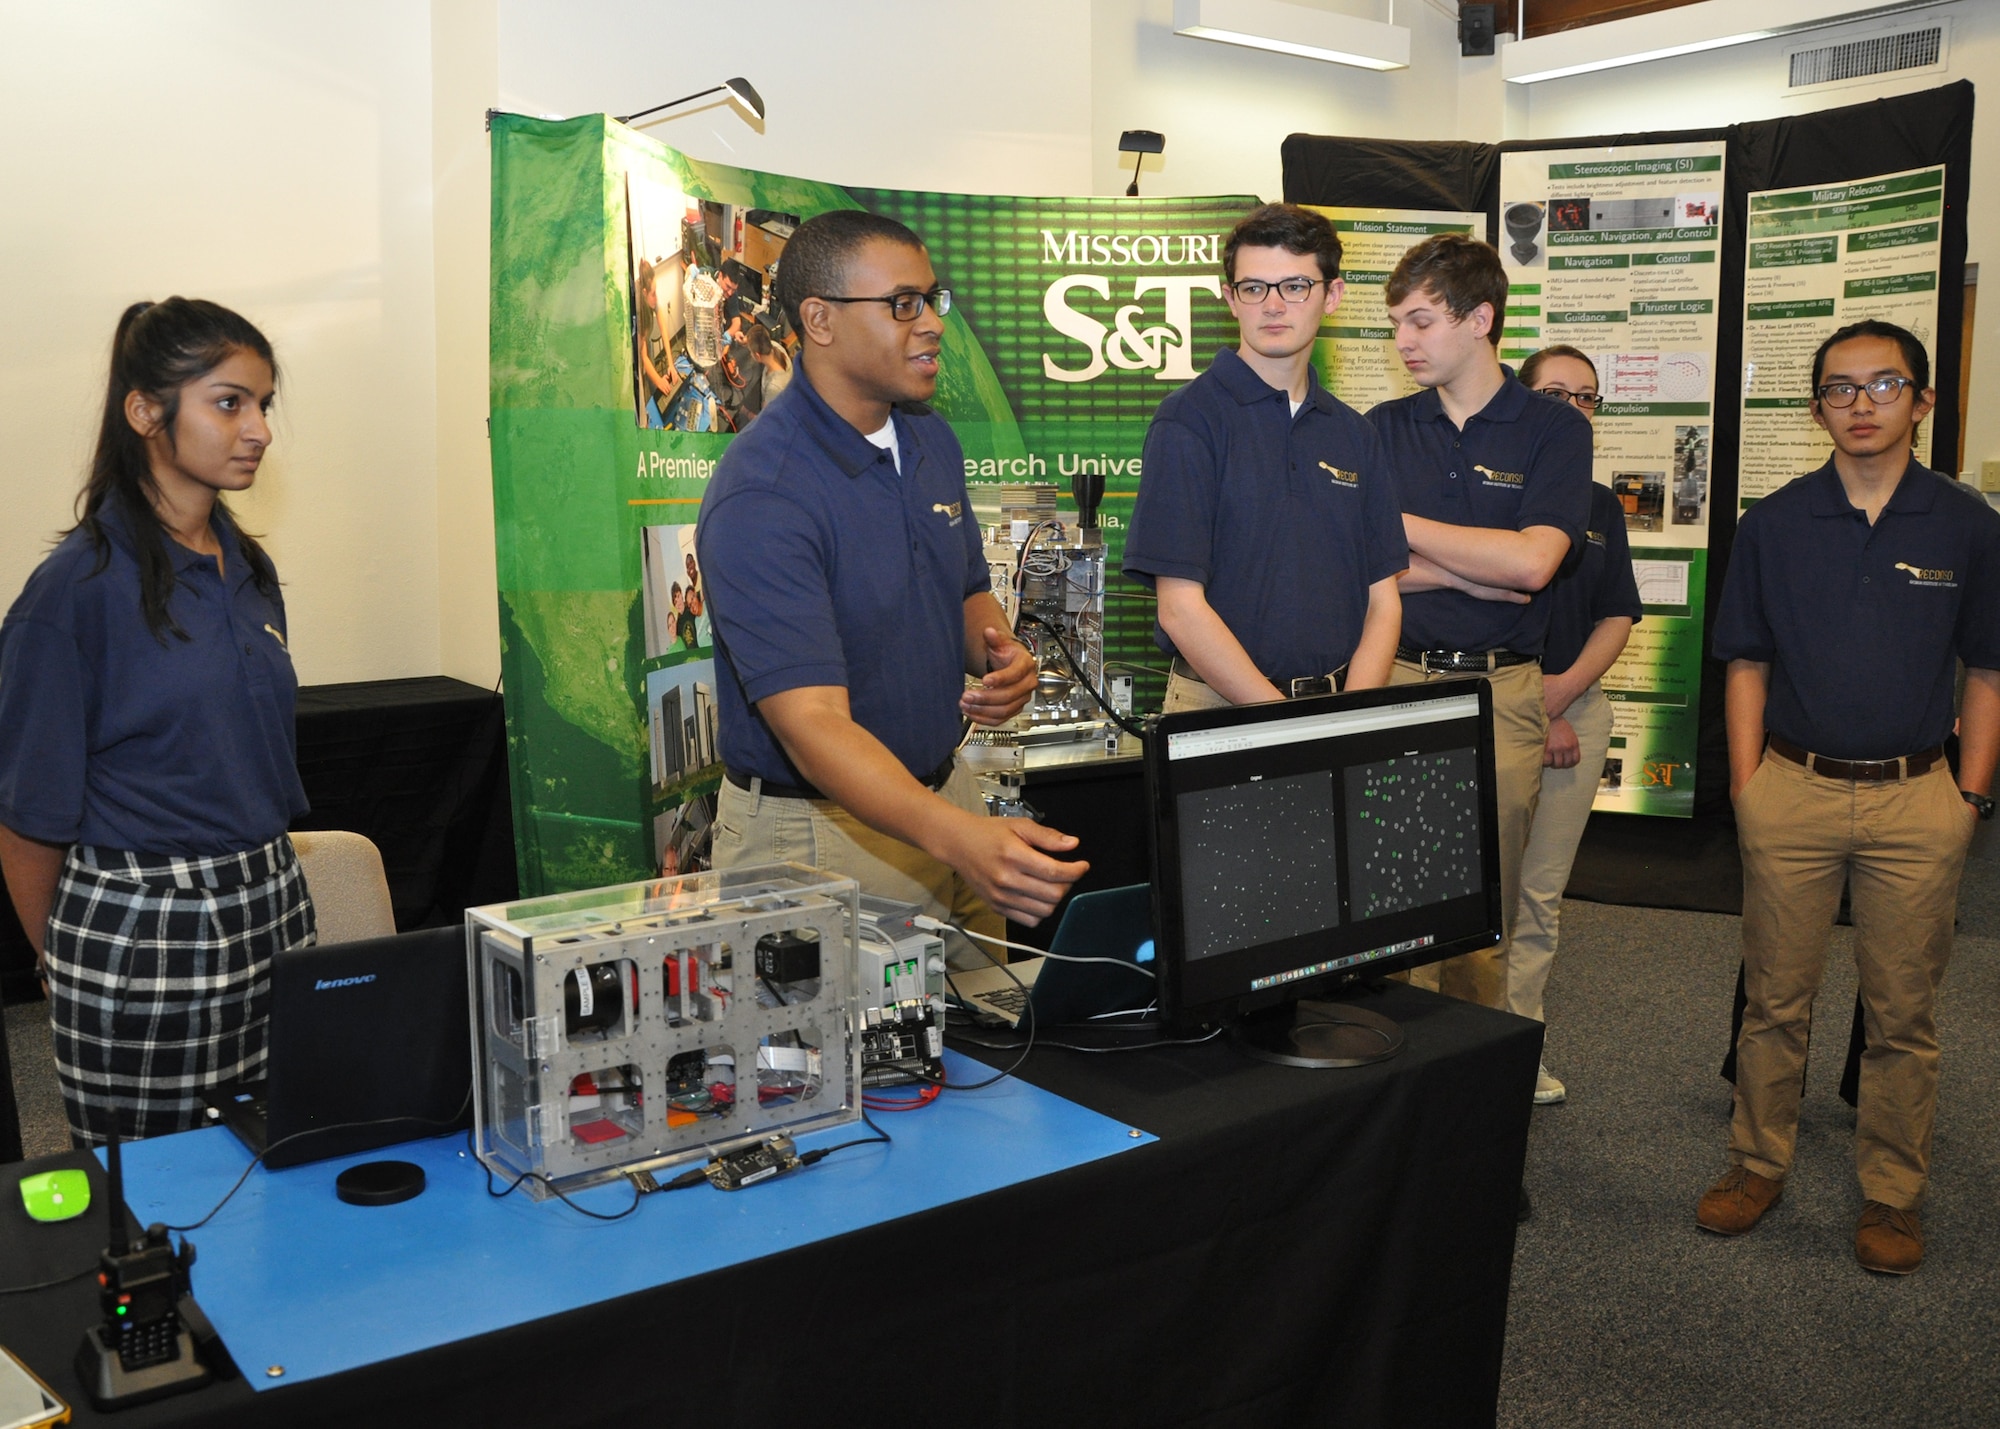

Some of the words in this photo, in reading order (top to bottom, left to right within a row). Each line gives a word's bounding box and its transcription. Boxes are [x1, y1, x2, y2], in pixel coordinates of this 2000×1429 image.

[1574, 161, 1632, 175] Stereoscopic
[1634, 161, 1673, 172] Imaging
[1675, 158, 1695, 172] (SI)
[1587, 182, 1614, 190] brightness
[1811, 190, 1847, 202] Military
[1848, 183, 1887, 198] Relevance
[1353, 222, 1384, 232] Mission
[1386, 223, 1428, 234] Statement
[1553, 232, 1598, 244] Guidance,
[1601, 231, 1653, 243] Navigation,
[1656, 230, 1674, 240] and
[1677, 228, 1712, 239] Control
[1867, 232, 1878, 240] Tech
[1040, 229, 1221, 266] MISSOURI
[1769, 241, 1791, 249] Research
[1804, 238, 1834, 247] Engineering
[1865, 240, 1891, 249] Functional
[1656, 253, 1691, 264] Control
[1784, 249, 1797, 257] S&T
[1564, 257, 1613, 268] Navigation
[1762, 259, 1796, 267] Communities
[1804, 256, 1823, 264] Interest
[1346, 271, 1390, 282] Experiment
[1891, 285, 1909, 293] Interest
[1638, 302, 1677, 312] Thruster
[1680, 301, 1706, 313] Logic
[1749, 304, 1772, 312] Ongoing
[1772, 302, 1805, 310] collaboration
[1818, 299, 1833, 307] AFRL
[1564, 312, 1607, 322] Guidance
[1043, 273, 1223, 383] S&T
[1360, 328, 1389, 338] Mission
[1336, 344, 1360, 353] Mission
[1361, 345, 1380, 353] Mode
[1382, 345, 1389, 353] 1:
[1332, 356, 1355, 365] Trailing
[1357, 356, 1390, 365] Formation
[1602, 404, 1650, 415] Propulsion
[637, 450, 648, 478] A
[650, 450, 717, 479] Premier
[964, 453, 1047, 477] earch
[1058, 453, 1142, 477] Unive
[1097, 514, 1126, 530] lla,
[314, 973, 378, 991] lenovo
[581, 981, 591, 1014] SAMPLE
